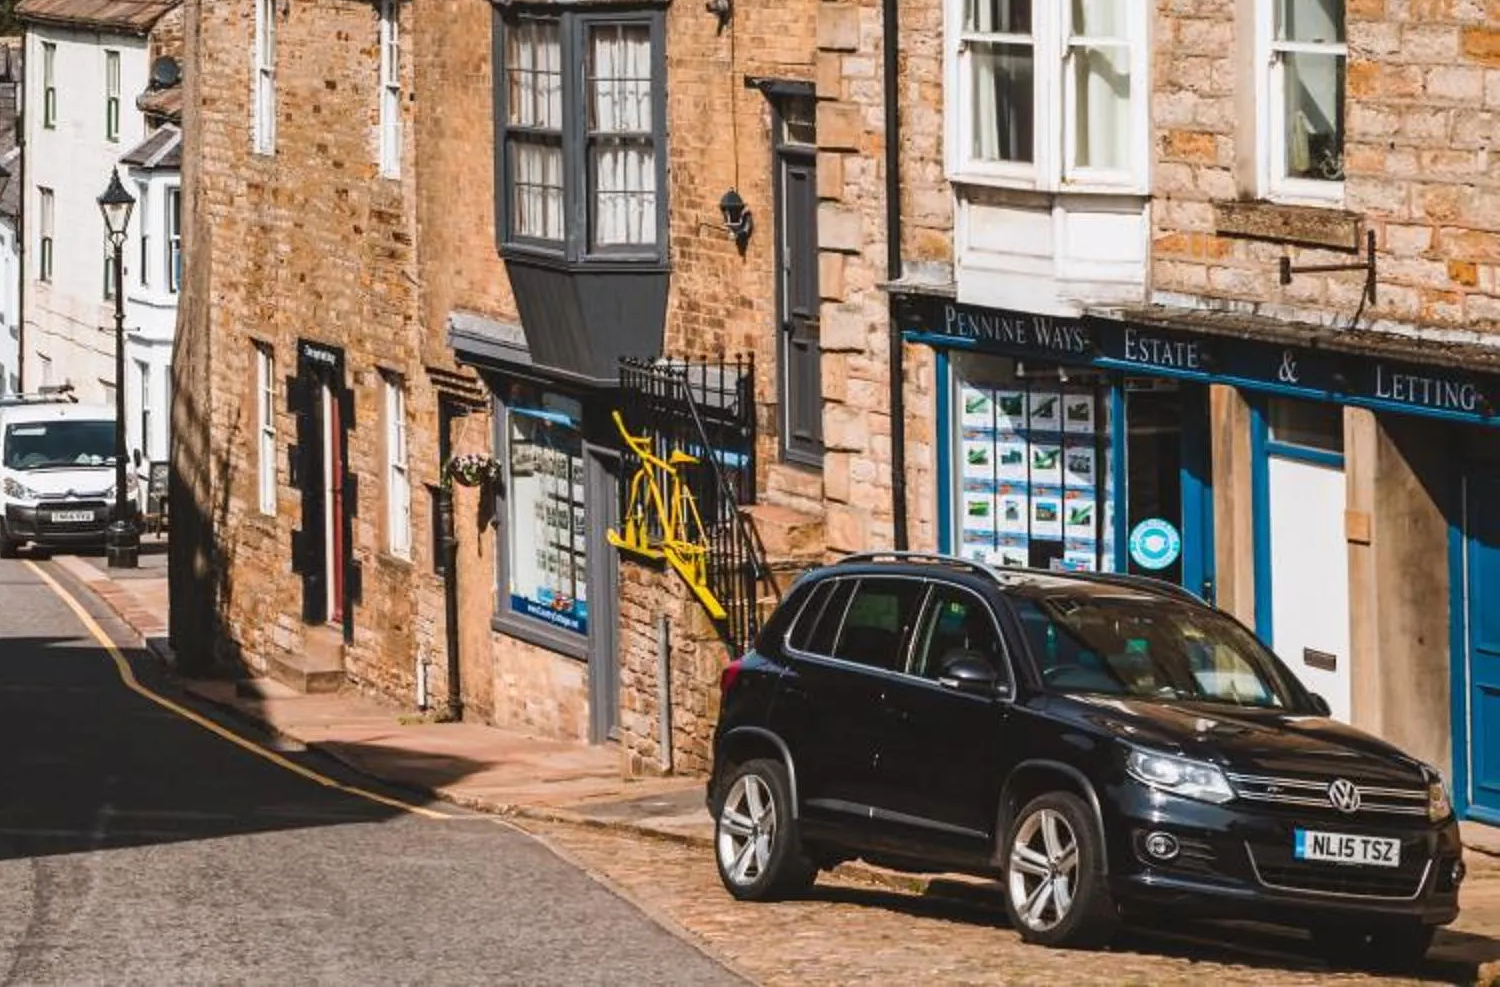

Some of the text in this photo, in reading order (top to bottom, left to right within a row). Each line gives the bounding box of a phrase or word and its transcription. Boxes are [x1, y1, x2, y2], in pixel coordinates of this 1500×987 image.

[944, 304, 1027, 344] PENNINE
[1123, 328, 1199, 368] ESTATE
[1278, 348, 1300, 383] &
[1375, 364, 1476, 411] LETTING
[1312, 834, 1394, 863] NL15 TSZ
